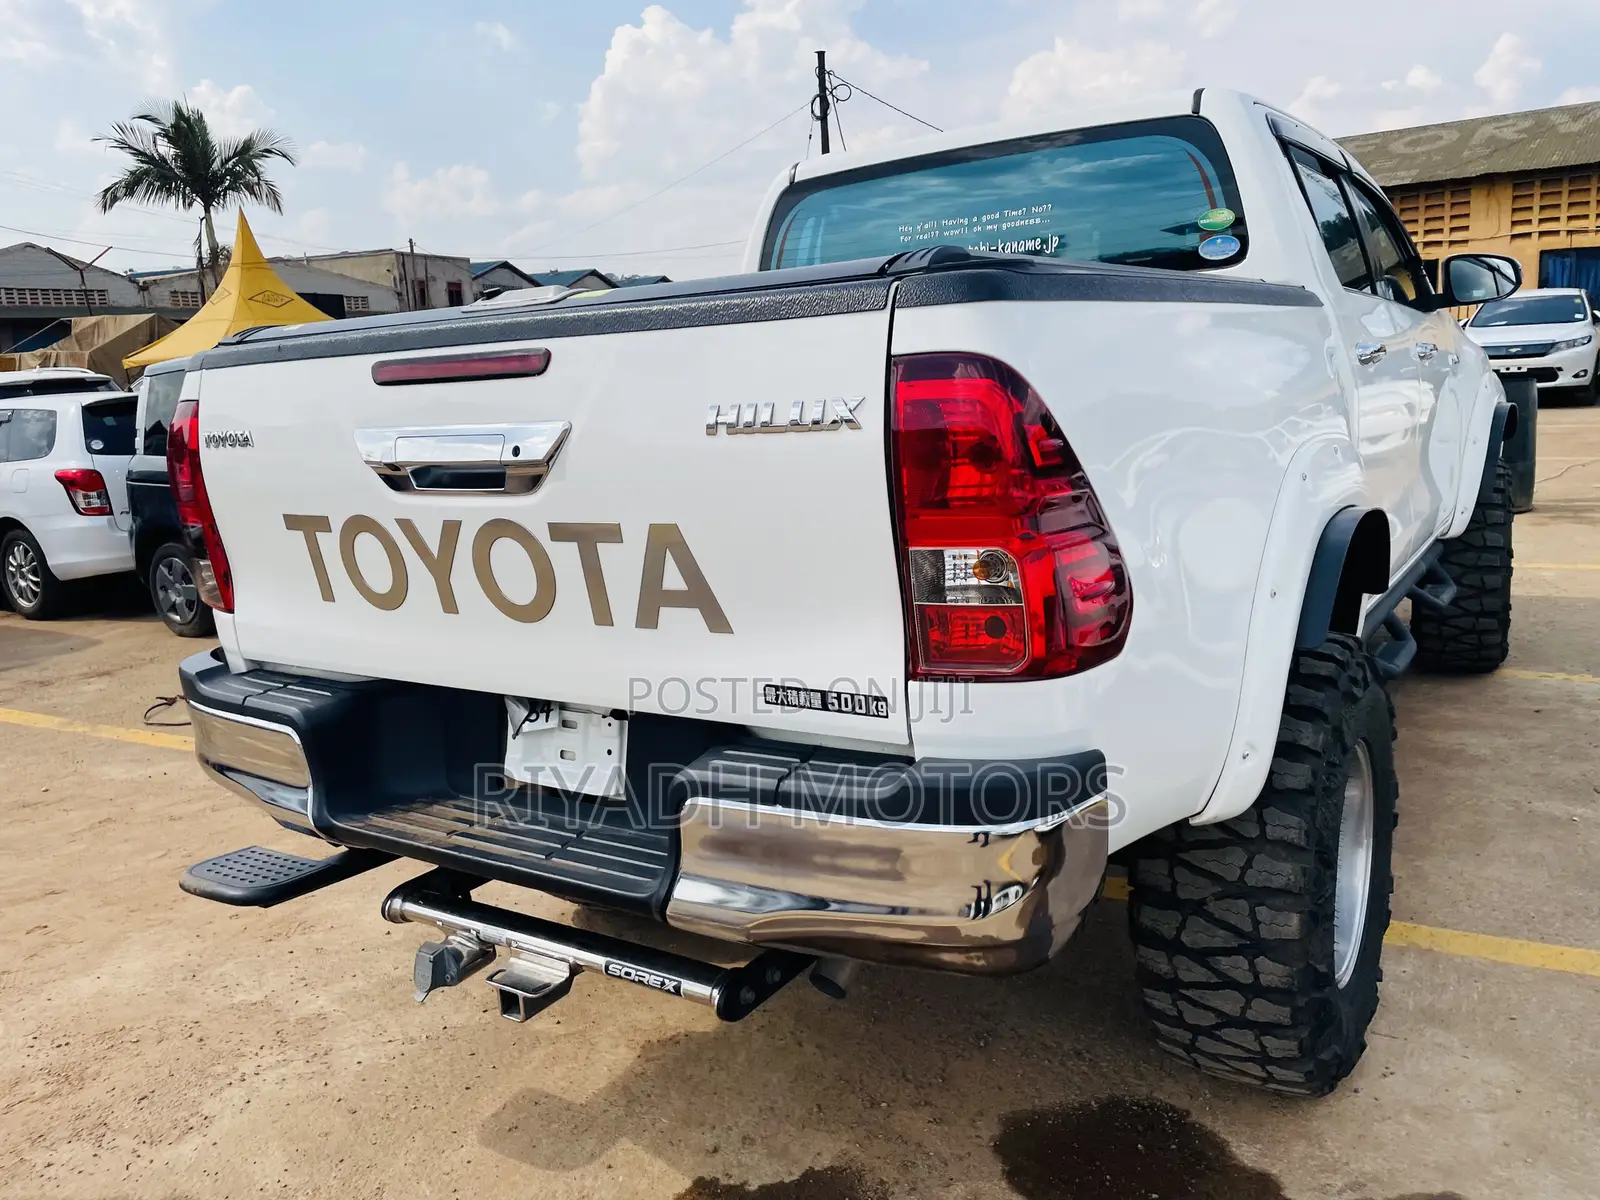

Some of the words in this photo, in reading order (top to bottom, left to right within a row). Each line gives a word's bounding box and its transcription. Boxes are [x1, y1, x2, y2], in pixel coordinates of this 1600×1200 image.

[898, 225, 913, 233] Hey
[942, 217, 969, 226] Having
[982, 212, 1000, 223] good
[1003, 207, 1027, 217] Time?
[1031, 203, 1052, 213] No??
[900, 235, 912, 243] For
[916, 230, 939, 240] real??
[973, 225, 982, 233] oh
[1001, 218, 1050, 231] goodness...
[706, 396, 866, 436] HILUX
[203, 430, 255, 449] TOYOTA
[282, 513, 734, 634] TOYOTA
[764, 686, 823, 709] 最大積載量
[826, 691, 888, 717] 500kg
[607, 963, 679, 993] SOREX
